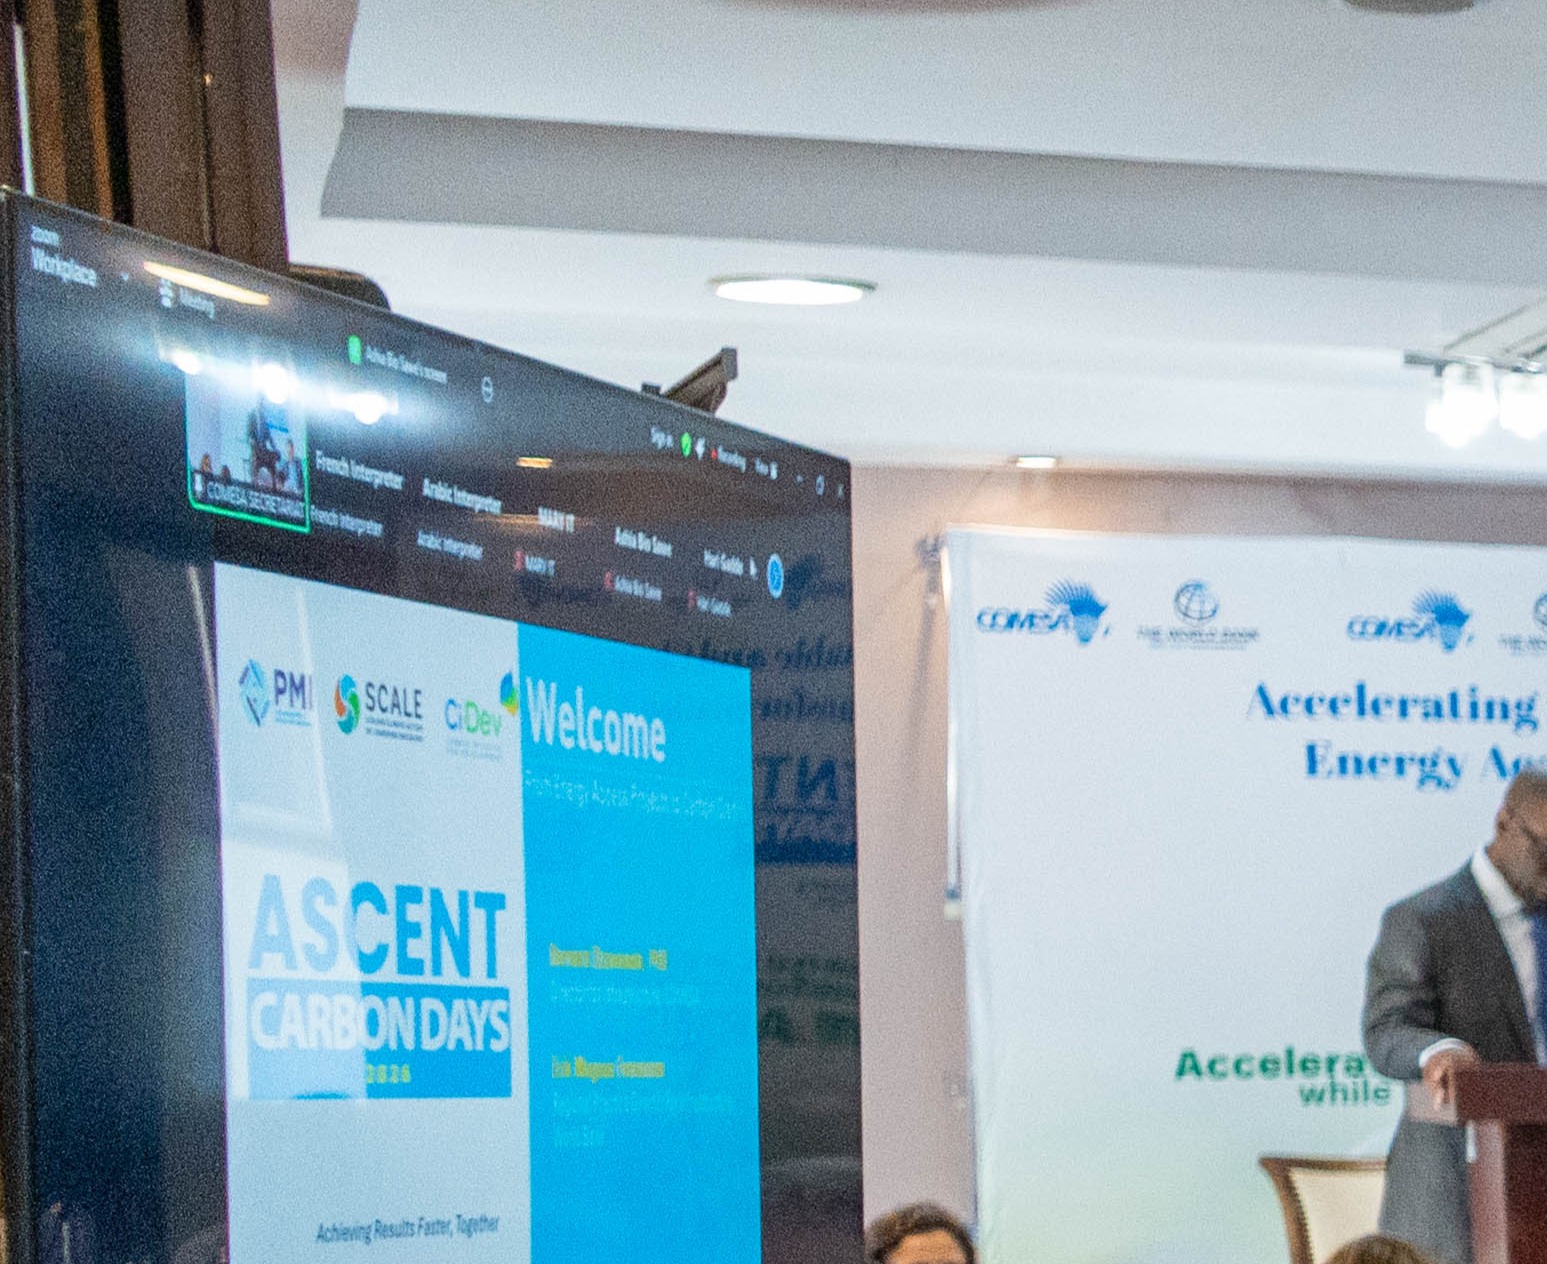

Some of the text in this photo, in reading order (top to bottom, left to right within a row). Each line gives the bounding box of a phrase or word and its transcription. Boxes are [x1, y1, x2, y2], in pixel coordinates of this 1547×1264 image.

[31, 246, 98, 288] Workplace
[976, 606, 1072, 633] COMESA
[1137, 627, 1259, 640] THE WORLD BANK
[1346, 615, 1437, 641] COMESA
[1499, 635, 1522, 647] THE
[273, 668, 313, 711] PMI
[365, 680, 423, 719] SCALE
[1246, 680, 1540, 738] Accelerating
[444, 697, 503, 737] CiDev
[526, 674, 665, 764] Welcome
[1304, 740, 1466, 791] Energy
[248, 873, 506, 980] ASCENT
[250, 991, 511, 1053] CARBON DAYS
[1176, 1046, 1366, 1081] Accelera
[1298, 1079, 1392, 1107] while
[316, 1221, 372, 1245] Achieving
[374, 1219, 415, 1239] Results
[456, 1213, 501, 1239] Together
